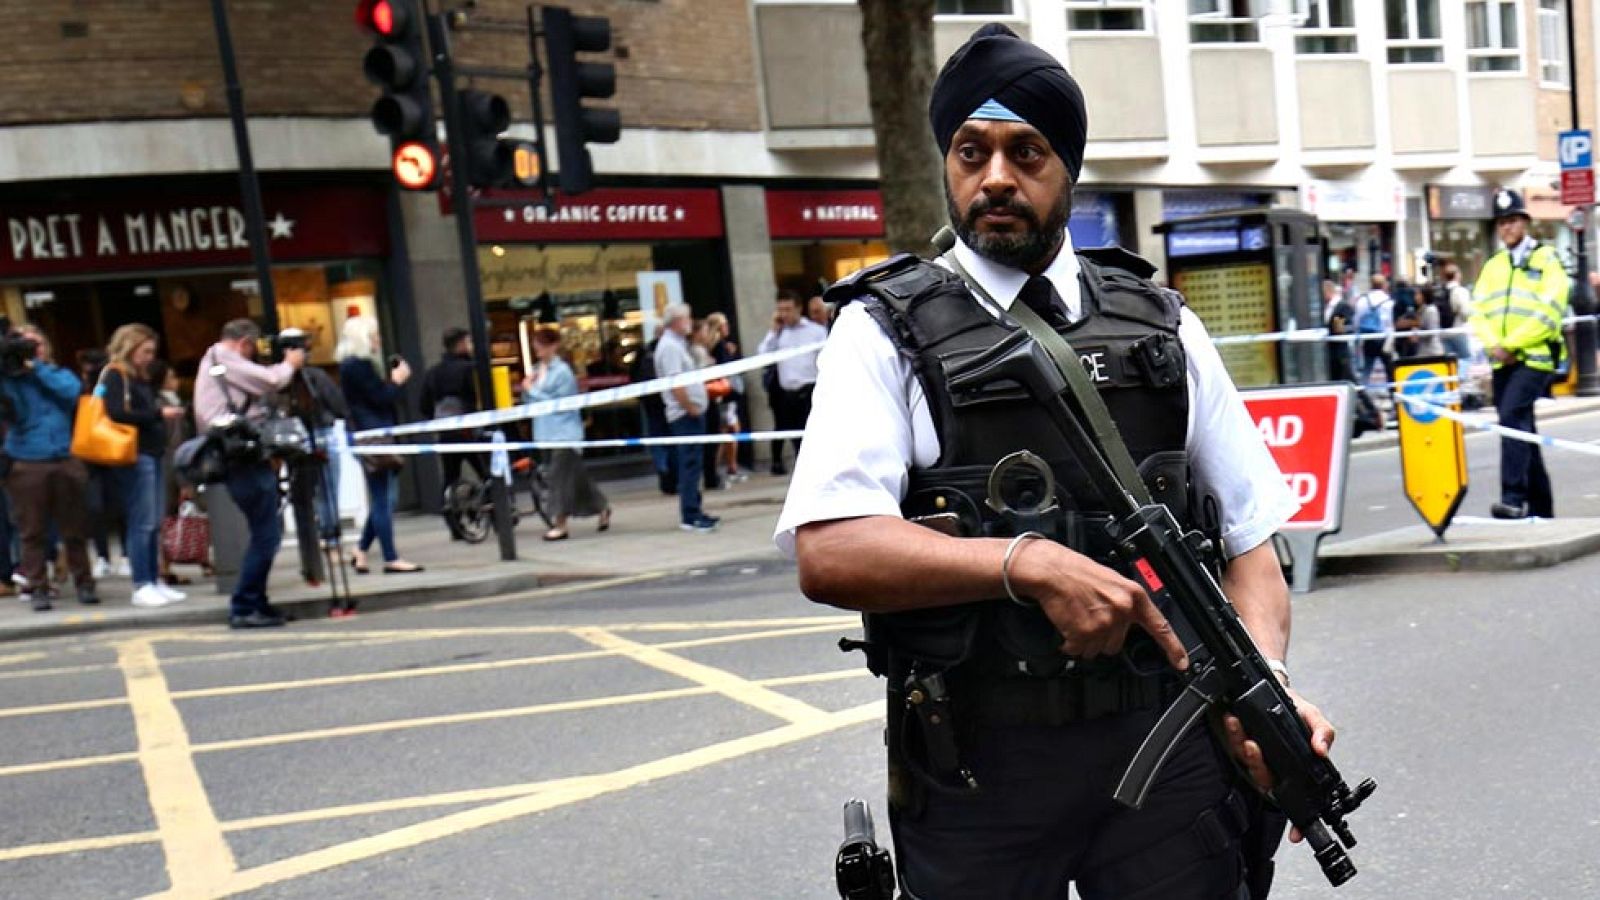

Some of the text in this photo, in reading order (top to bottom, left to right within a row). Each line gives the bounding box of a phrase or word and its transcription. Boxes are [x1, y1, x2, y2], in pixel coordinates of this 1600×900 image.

[606, 205, 668, 222] COFFEE
[816, 205, 878, 221] NATURAL
[8, 206, 249, 261] PRET A MANGER
[1258, 414, 1304, 447] AD
